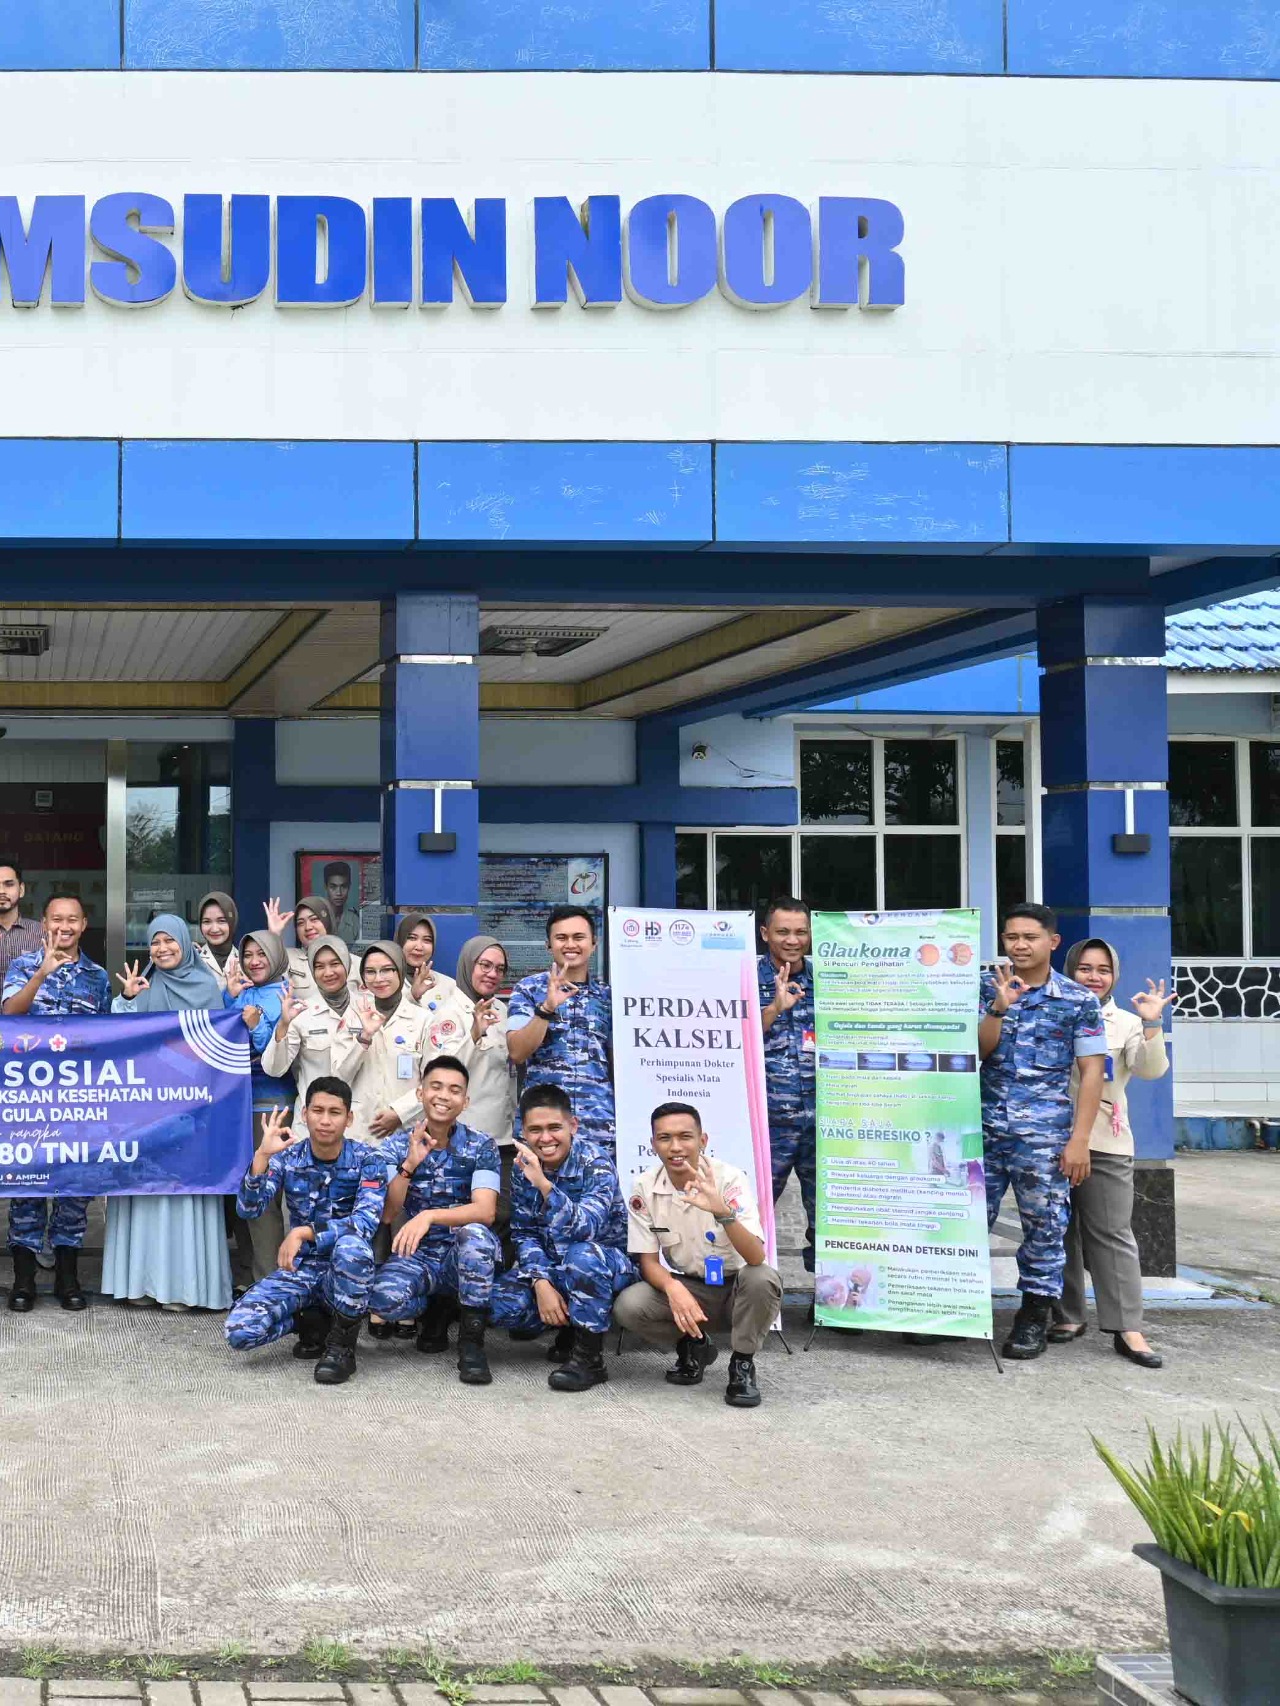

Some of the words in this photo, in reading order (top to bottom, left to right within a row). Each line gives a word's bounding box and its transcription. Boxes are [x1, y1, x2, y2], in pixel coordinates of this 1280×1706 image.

[532, 193, 905, 311] NOOR
[818, 942, 911, 958] Glaukoma
[623, 996, 750, 1019] PERDAMI
[633, 1028, 741, 1049] KALSEL
[640, 1058, 701, 1069] Perhimpunan
[704, 1059, 735, 1068] Dokter
[4, 1059, 146, 1087] SOSIAL
[656, 1073, 695, 1083] Spesialis
[697, 1074, 721, 1083] Mata
[57, 1087, 153, 1103] KESEHATAN
[157, 1086, 213, 1103] UMUM,
[667, 1088, 711, 1098] Indonesia
[2, 1108, 46, 1122] GULA
[50, 1107, 108, 1122] DARAH
[9, 1123, 62, 1148] rangka
[820, 1127, 854, 1139] YANG
[857, 1129, 921, 1142] BERESIKO
[924, 1131, 931, 1143] ?
[40, 1142, 89, 1165] TNI
[98, 1140, 139, 1163] AU
[825, 1239, 890, 1252] PENCEGAHAN
[892, 1244, 913, 1254] DAN
[915, 1246, 956, 1257] DETEKSI
[958, 1249, 978, 1258] DINI
